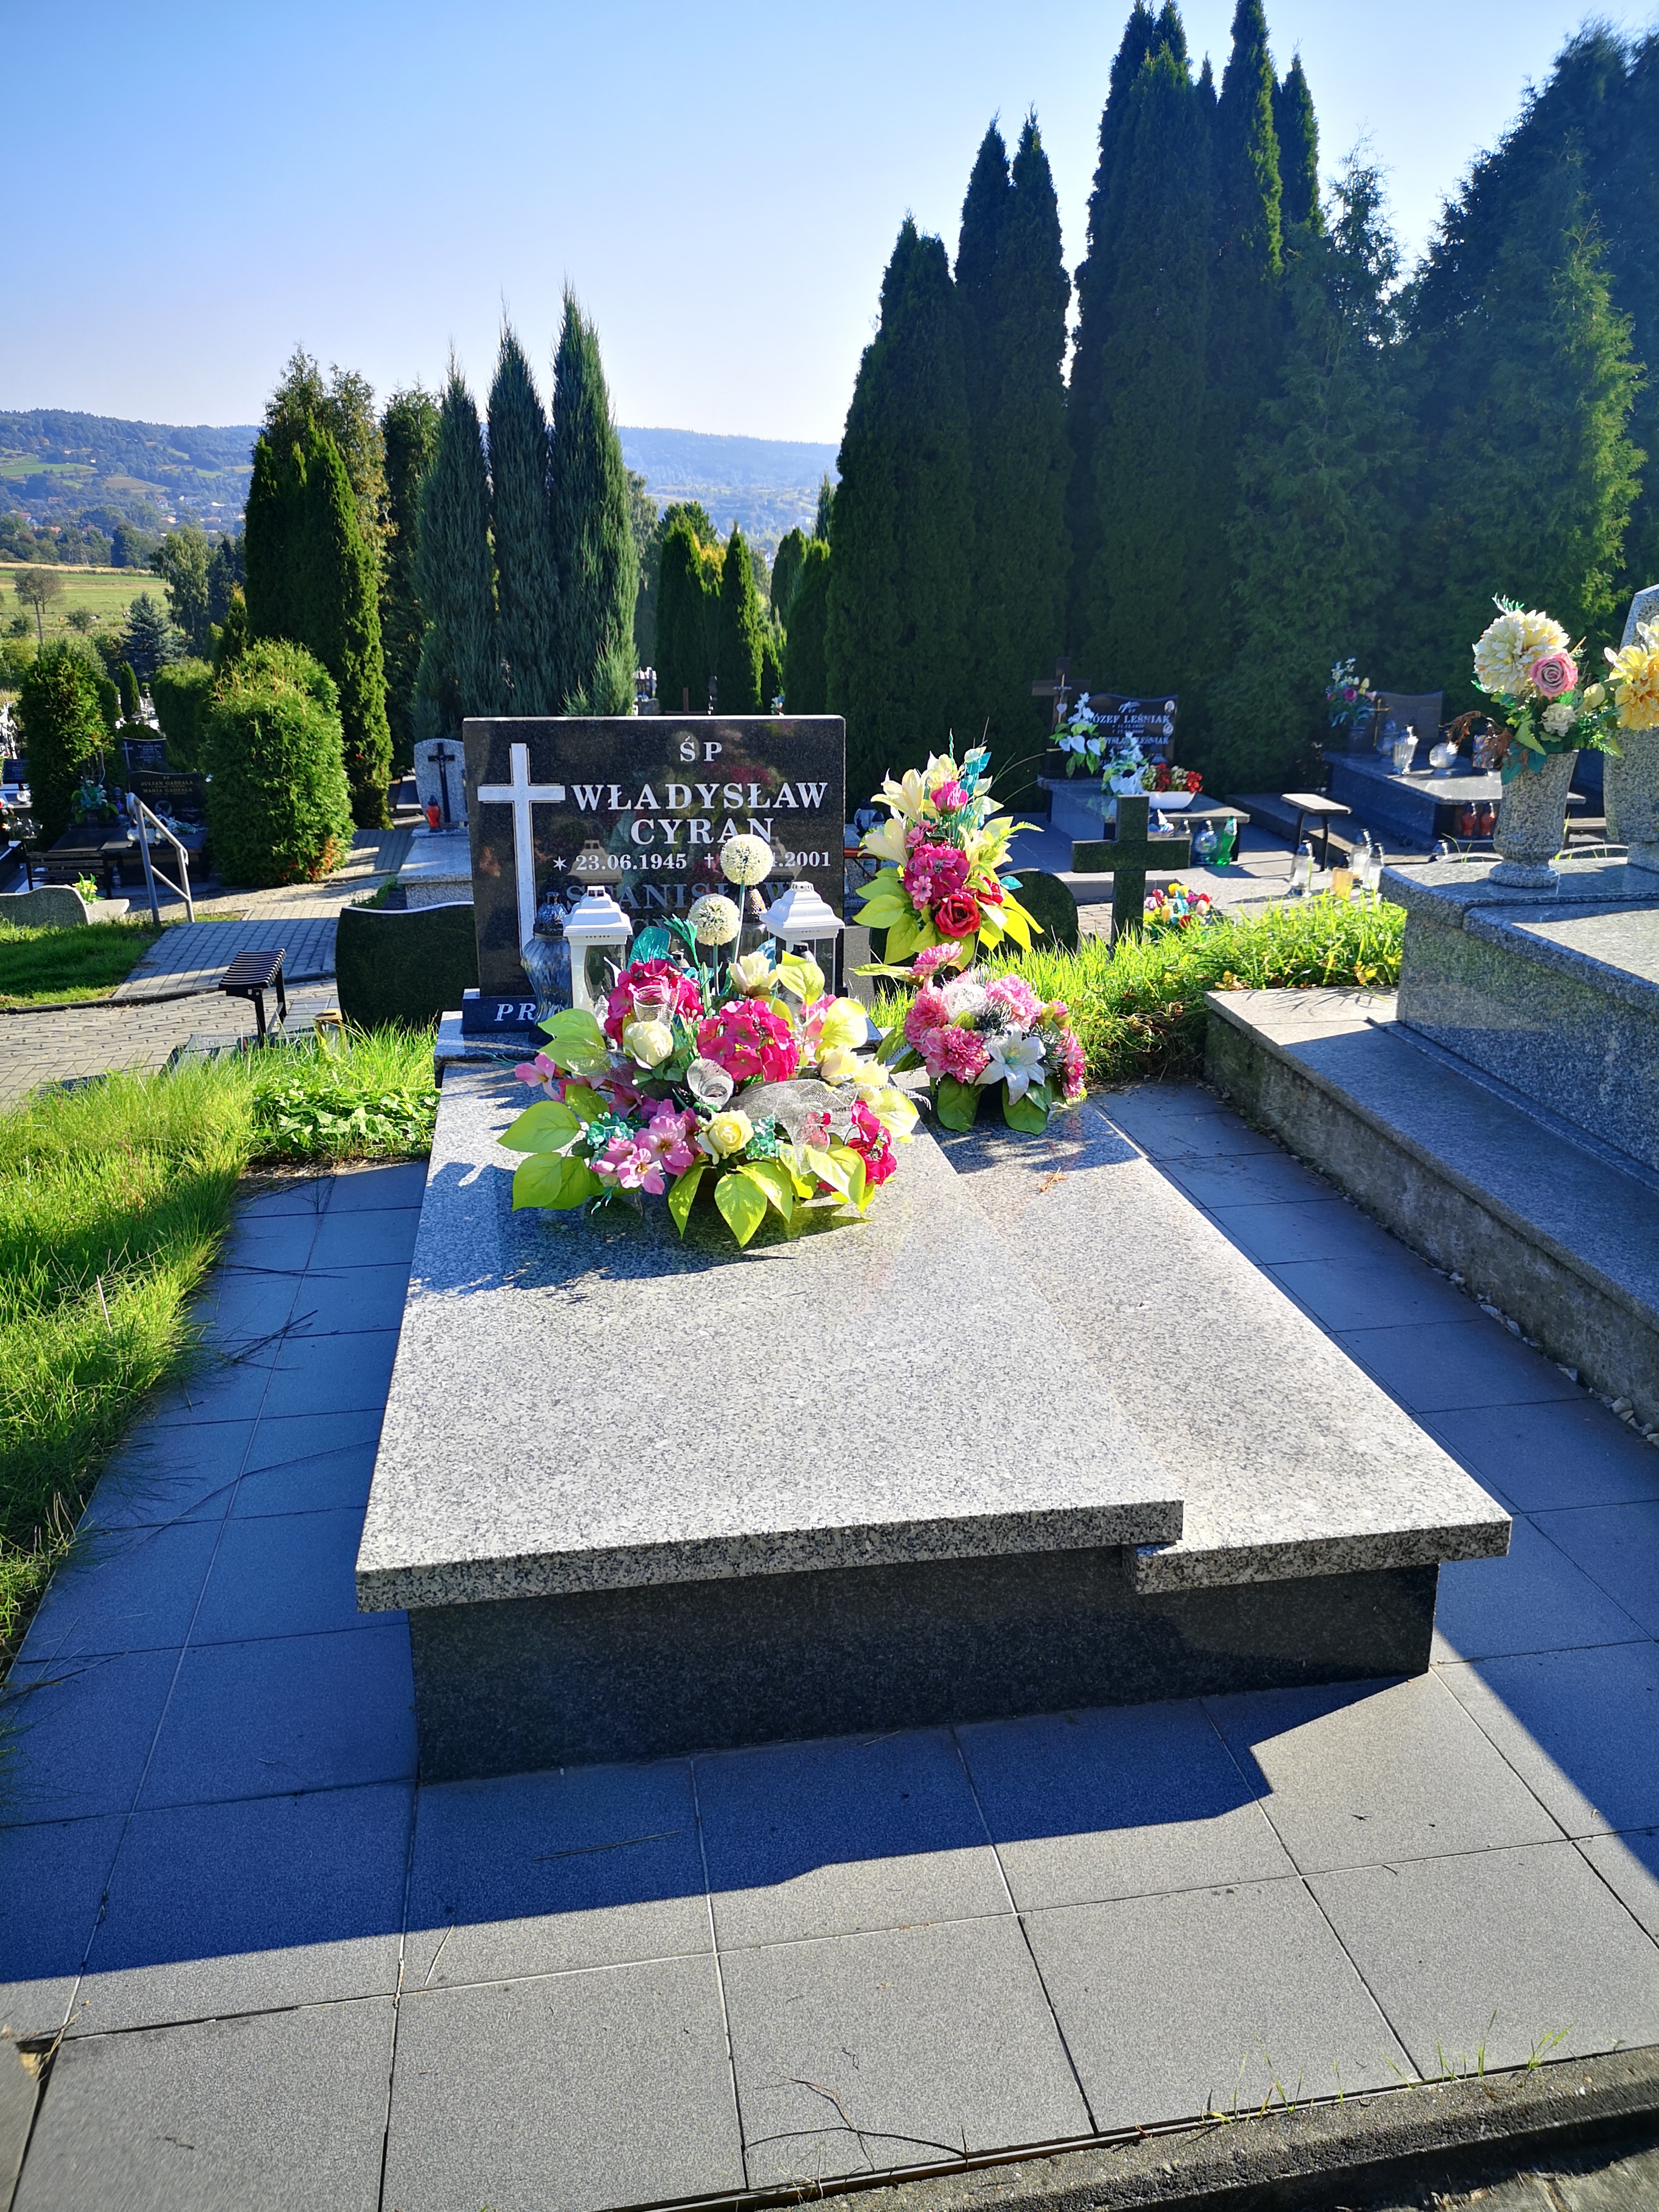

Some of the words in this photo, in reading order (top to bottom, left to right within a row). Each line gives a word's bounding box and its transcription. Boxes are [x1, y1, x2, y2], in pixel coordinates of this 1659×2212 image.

[1092, 712, 1121, 723] ÓZEF
[571, 782, 828, 811] WŁADYSŁAW
[631, 817, 774, 846] CYRAN
[575, 853, 687, 871] 23.06.1945
